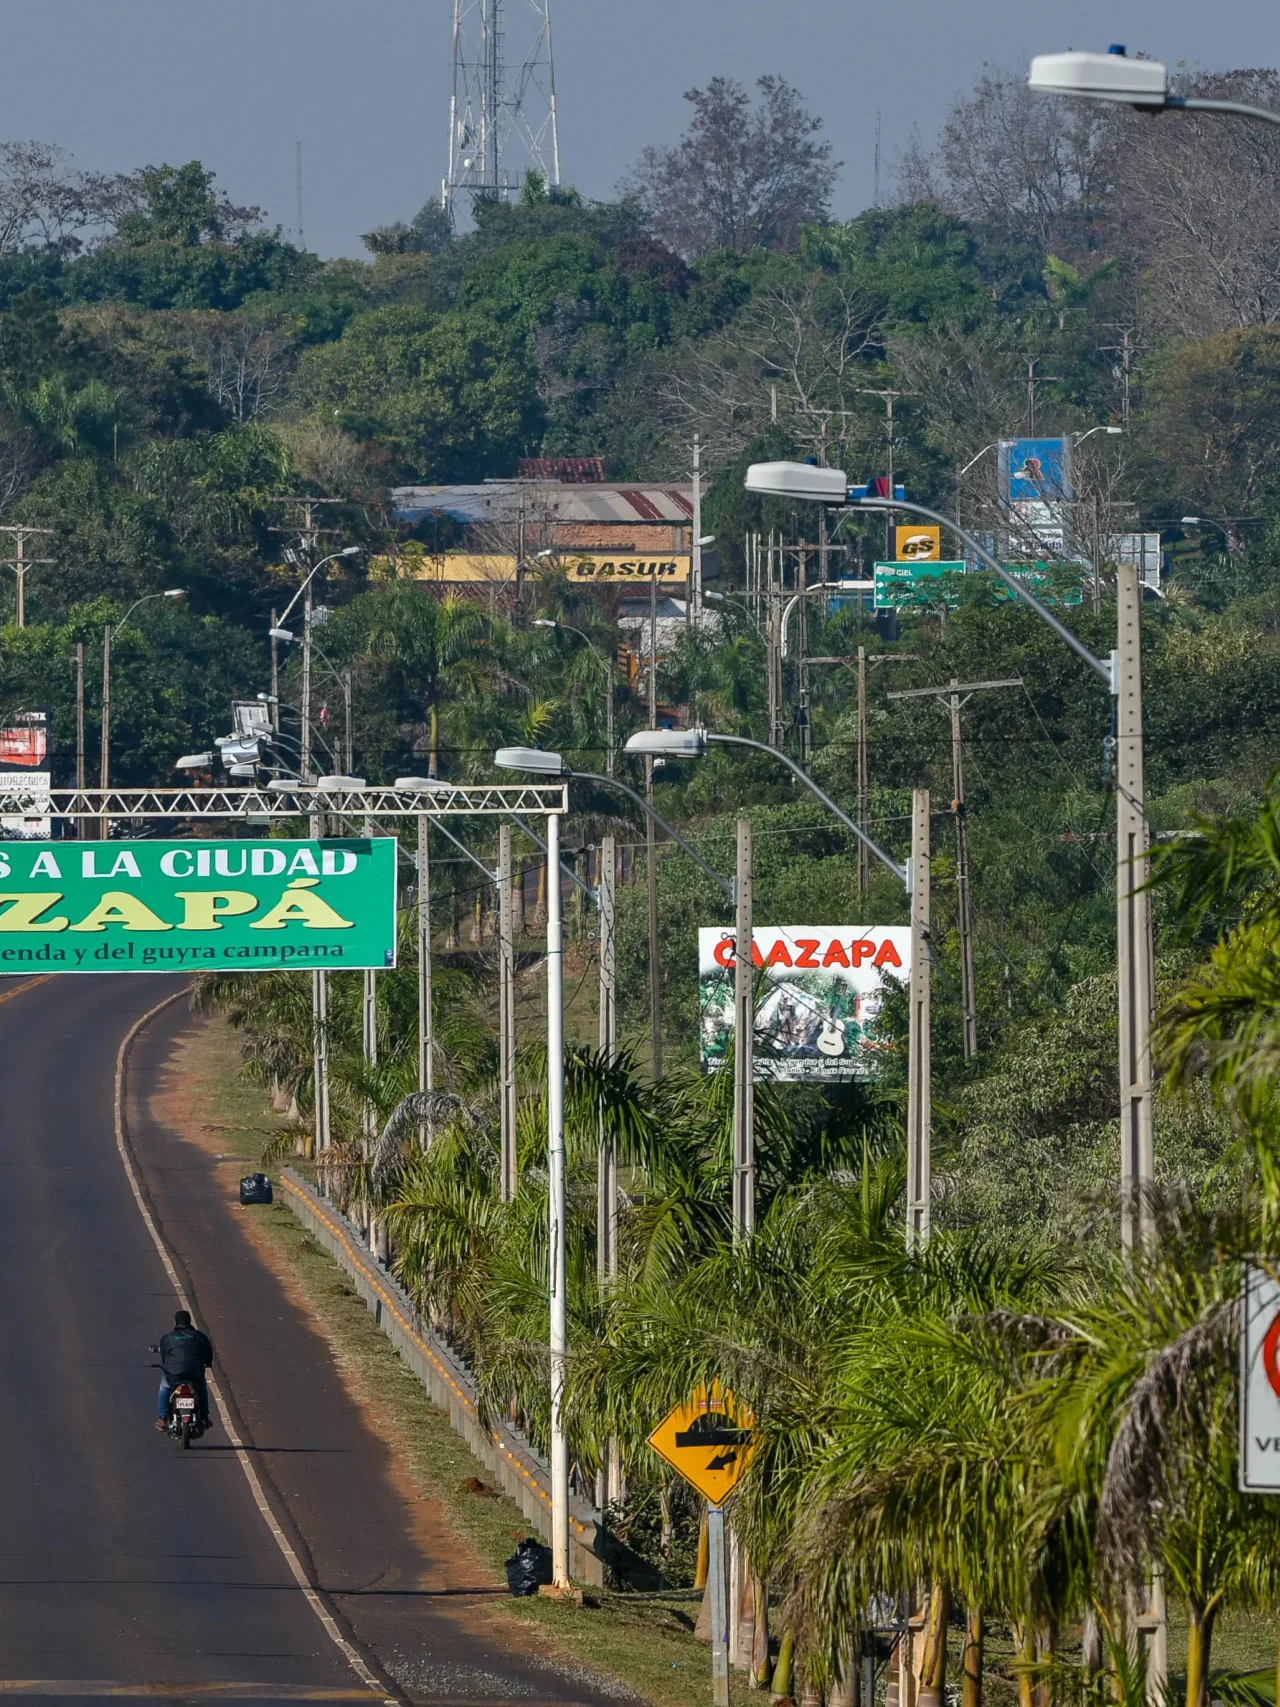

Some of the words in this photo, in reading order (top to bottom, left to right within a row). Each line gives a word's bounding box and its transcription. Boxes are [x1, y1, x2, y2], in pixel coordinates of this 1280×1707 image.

[902, 540, 935, 554] GS
[576, 562, 677, 576] GASUR
[29, 851, 62, 879] A
[82, 850, 142, 878] LA
[160, 849, 358, 878] CIUDAD
[75, 948, 86, 966] y
[94, 942, 134, 960] del
[142, 947, 216, 965] guyra
[223, 945, 344, 962] campana
